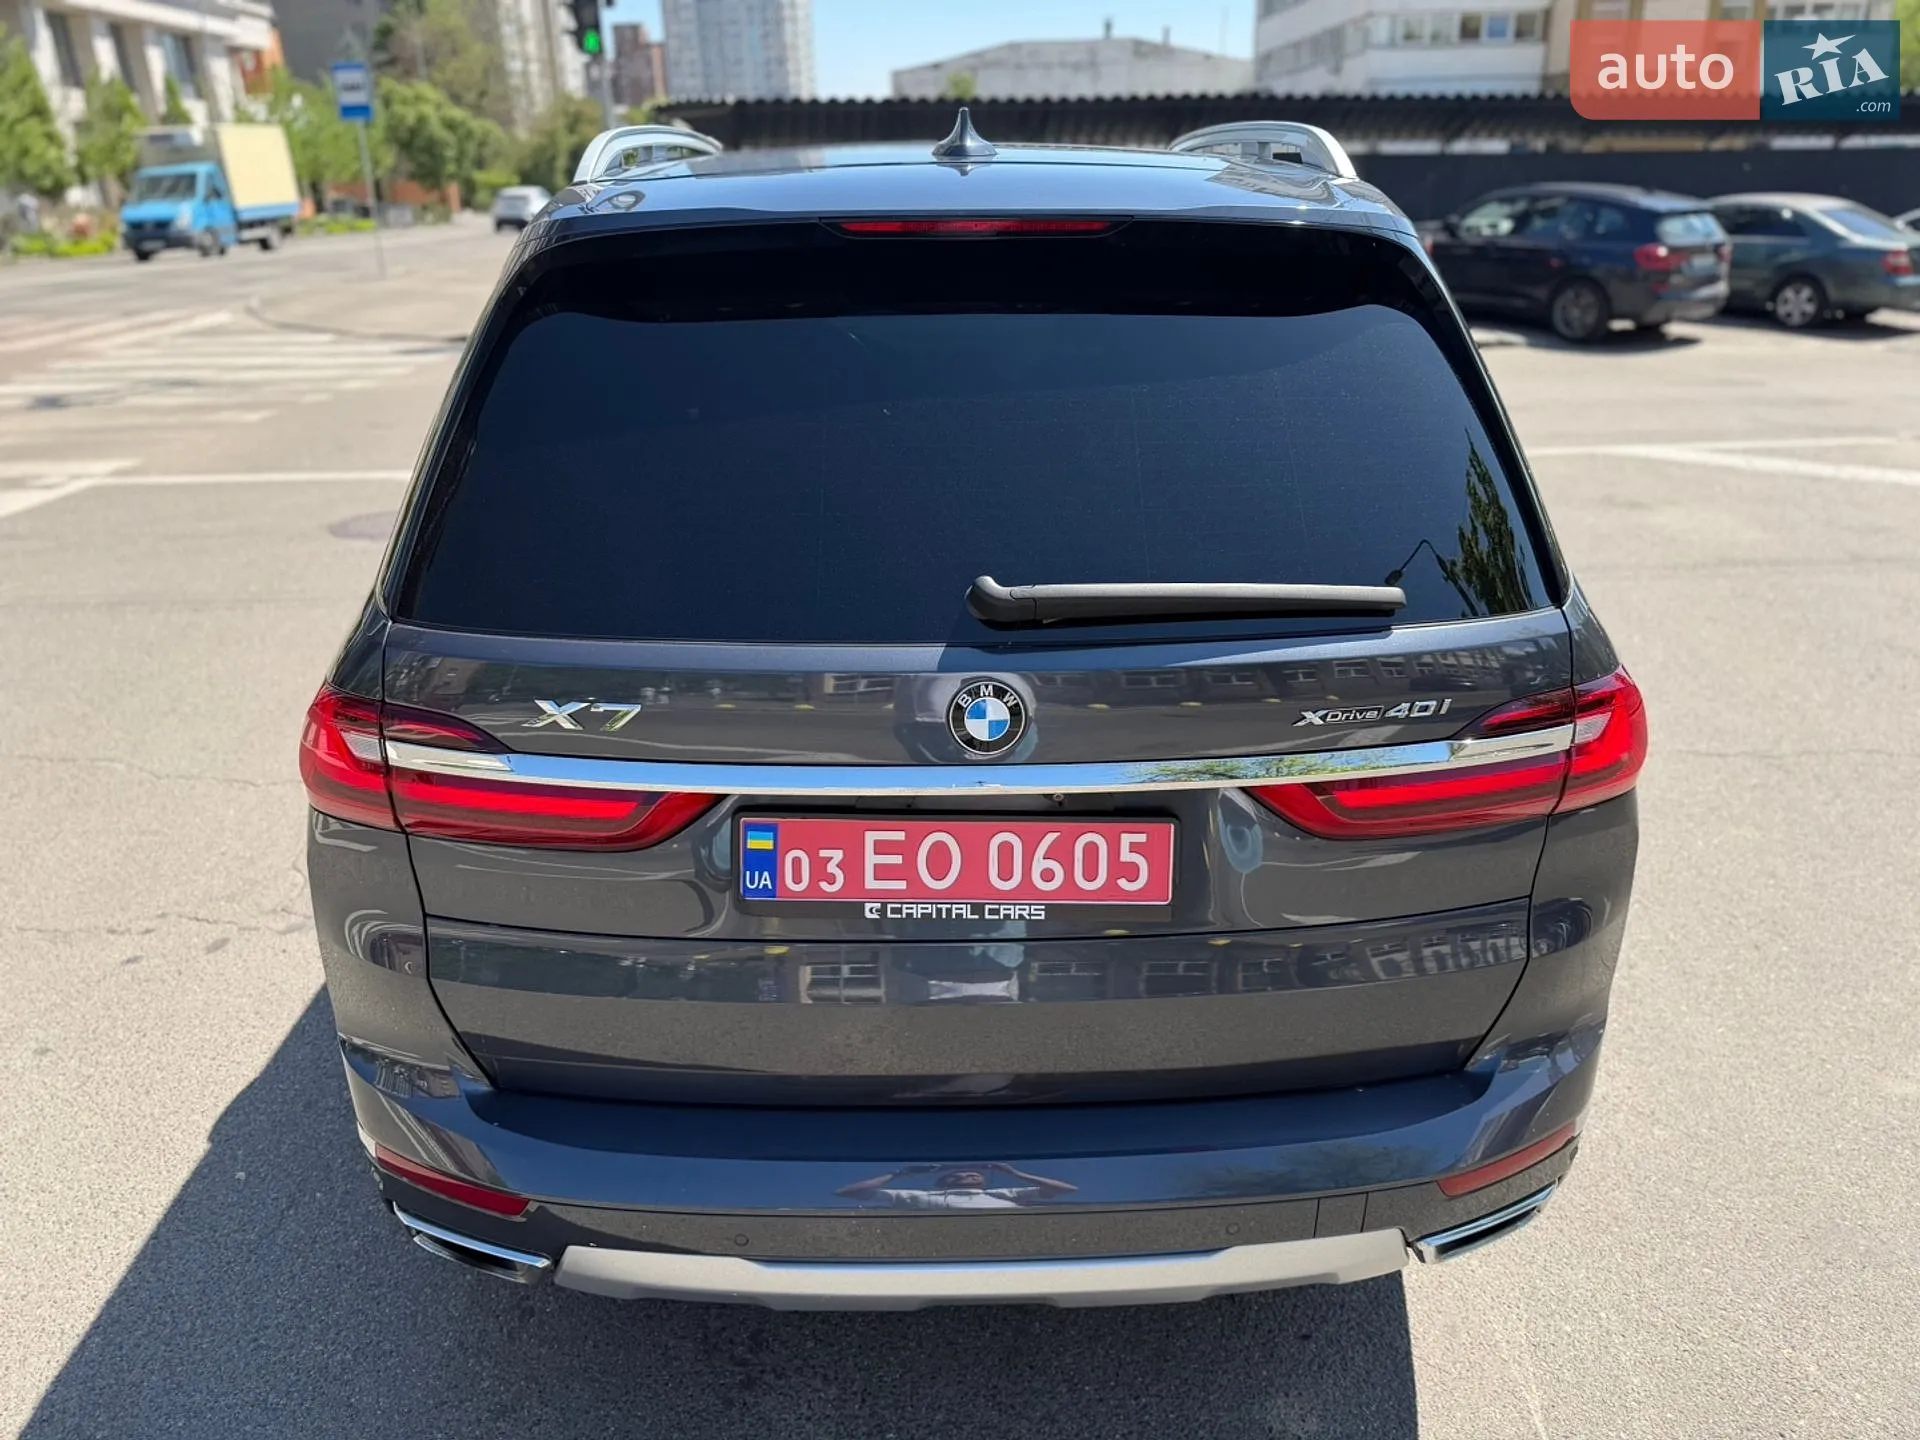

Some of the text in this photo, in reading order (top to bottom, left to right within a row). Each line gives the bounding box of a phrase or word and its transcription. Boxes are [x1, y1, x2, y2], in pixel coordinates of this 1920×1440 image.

[957, 684, 1018, 708] BMW
[521, 699, 642, 731] X7
[784, 830, 1149, 892] 03 EO 0605
[745, 871, 773, 890] UA
[887, 903, 1046, 920] CAPITAL CARS
